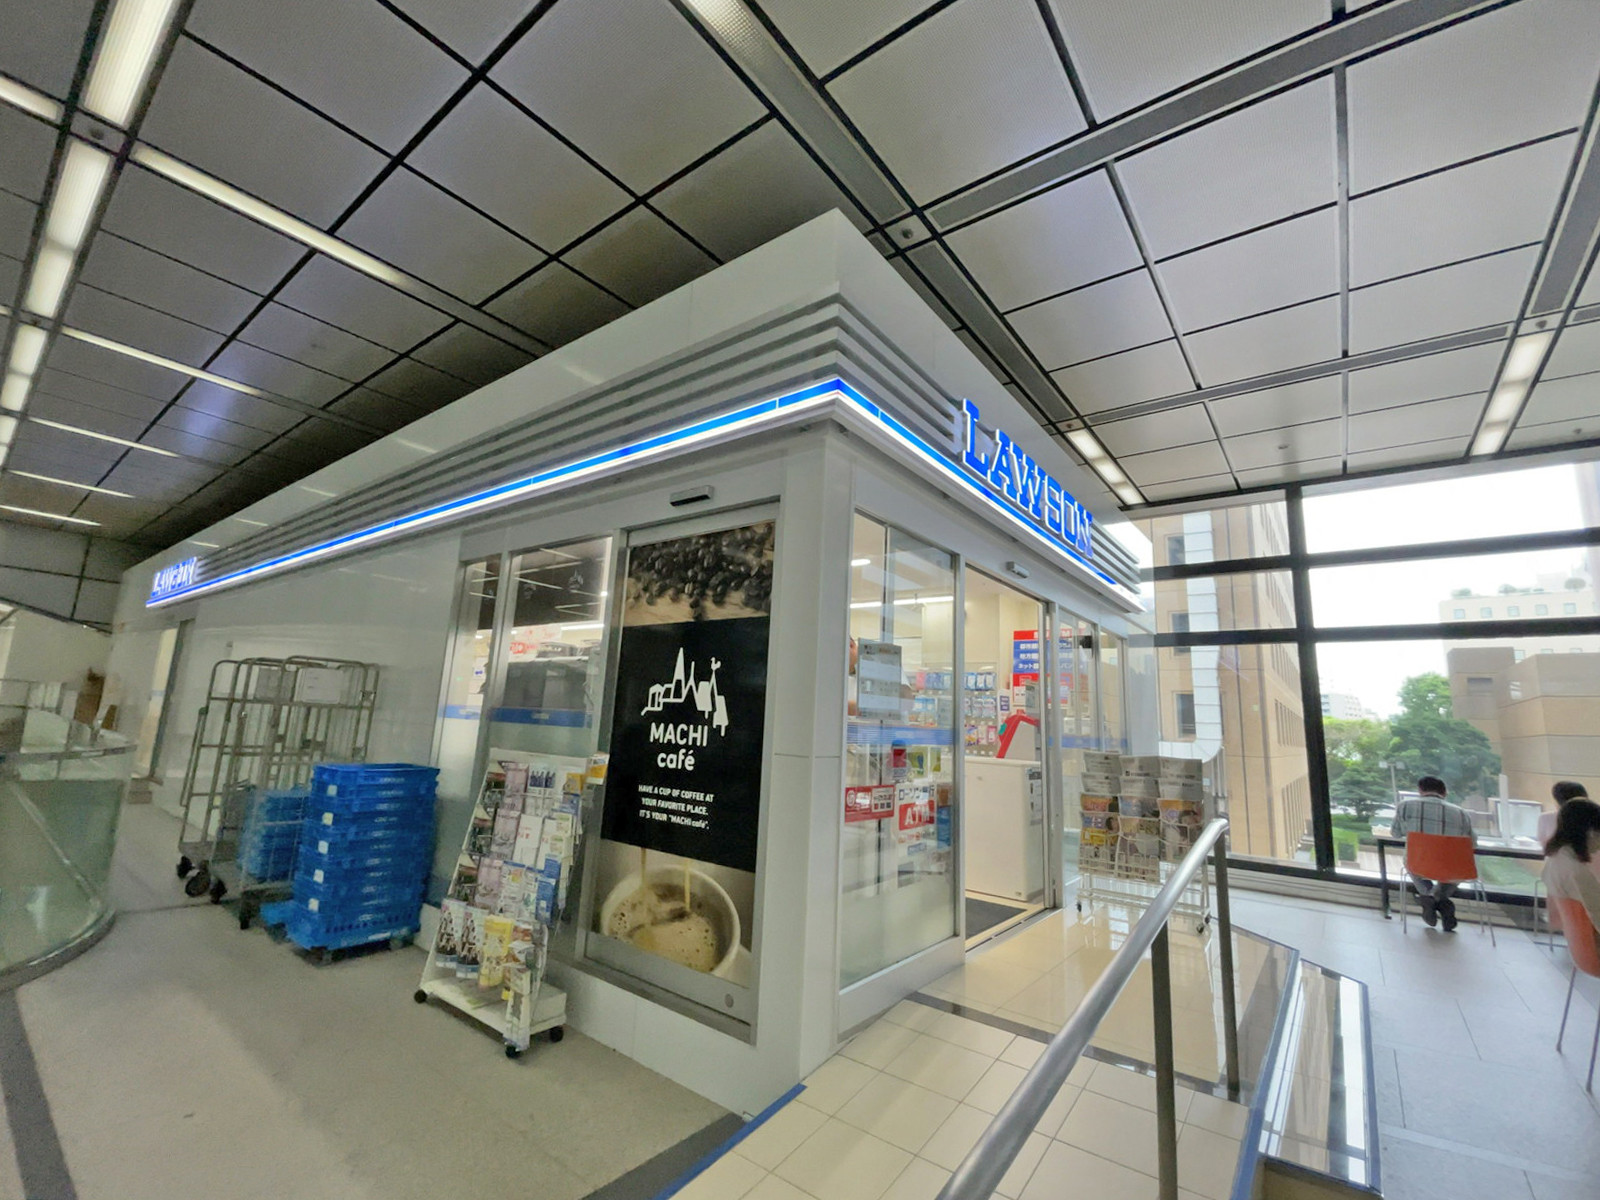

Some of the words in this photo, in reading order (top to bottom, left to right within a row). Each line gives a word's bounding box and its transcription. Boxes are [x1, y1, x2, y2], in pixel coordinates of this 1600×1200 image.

[963, 398, 1093, 559] LAWSON
[151, 556, 197, 597] LAWSON
[649, 722, 709, 747] MACHI
[657, 749, 696, 771] café
[638, 784, 654, 794] HAVE
[653, 786, 659, 794] A
[658, 787, 672, 796] CUP
[671, 788, 681, 797] OF
[680, 790, 706, 801] COFFEE
[705, 793, 715, 803] AT
[641, 797, 657, 806] YOUR
[657, 799, 686, 812] FAVORITE
[686, 804, 709, 815] PLACE.
[651, 811, 668, 821] YOUR
[904, 804, 930, 826] ATM
